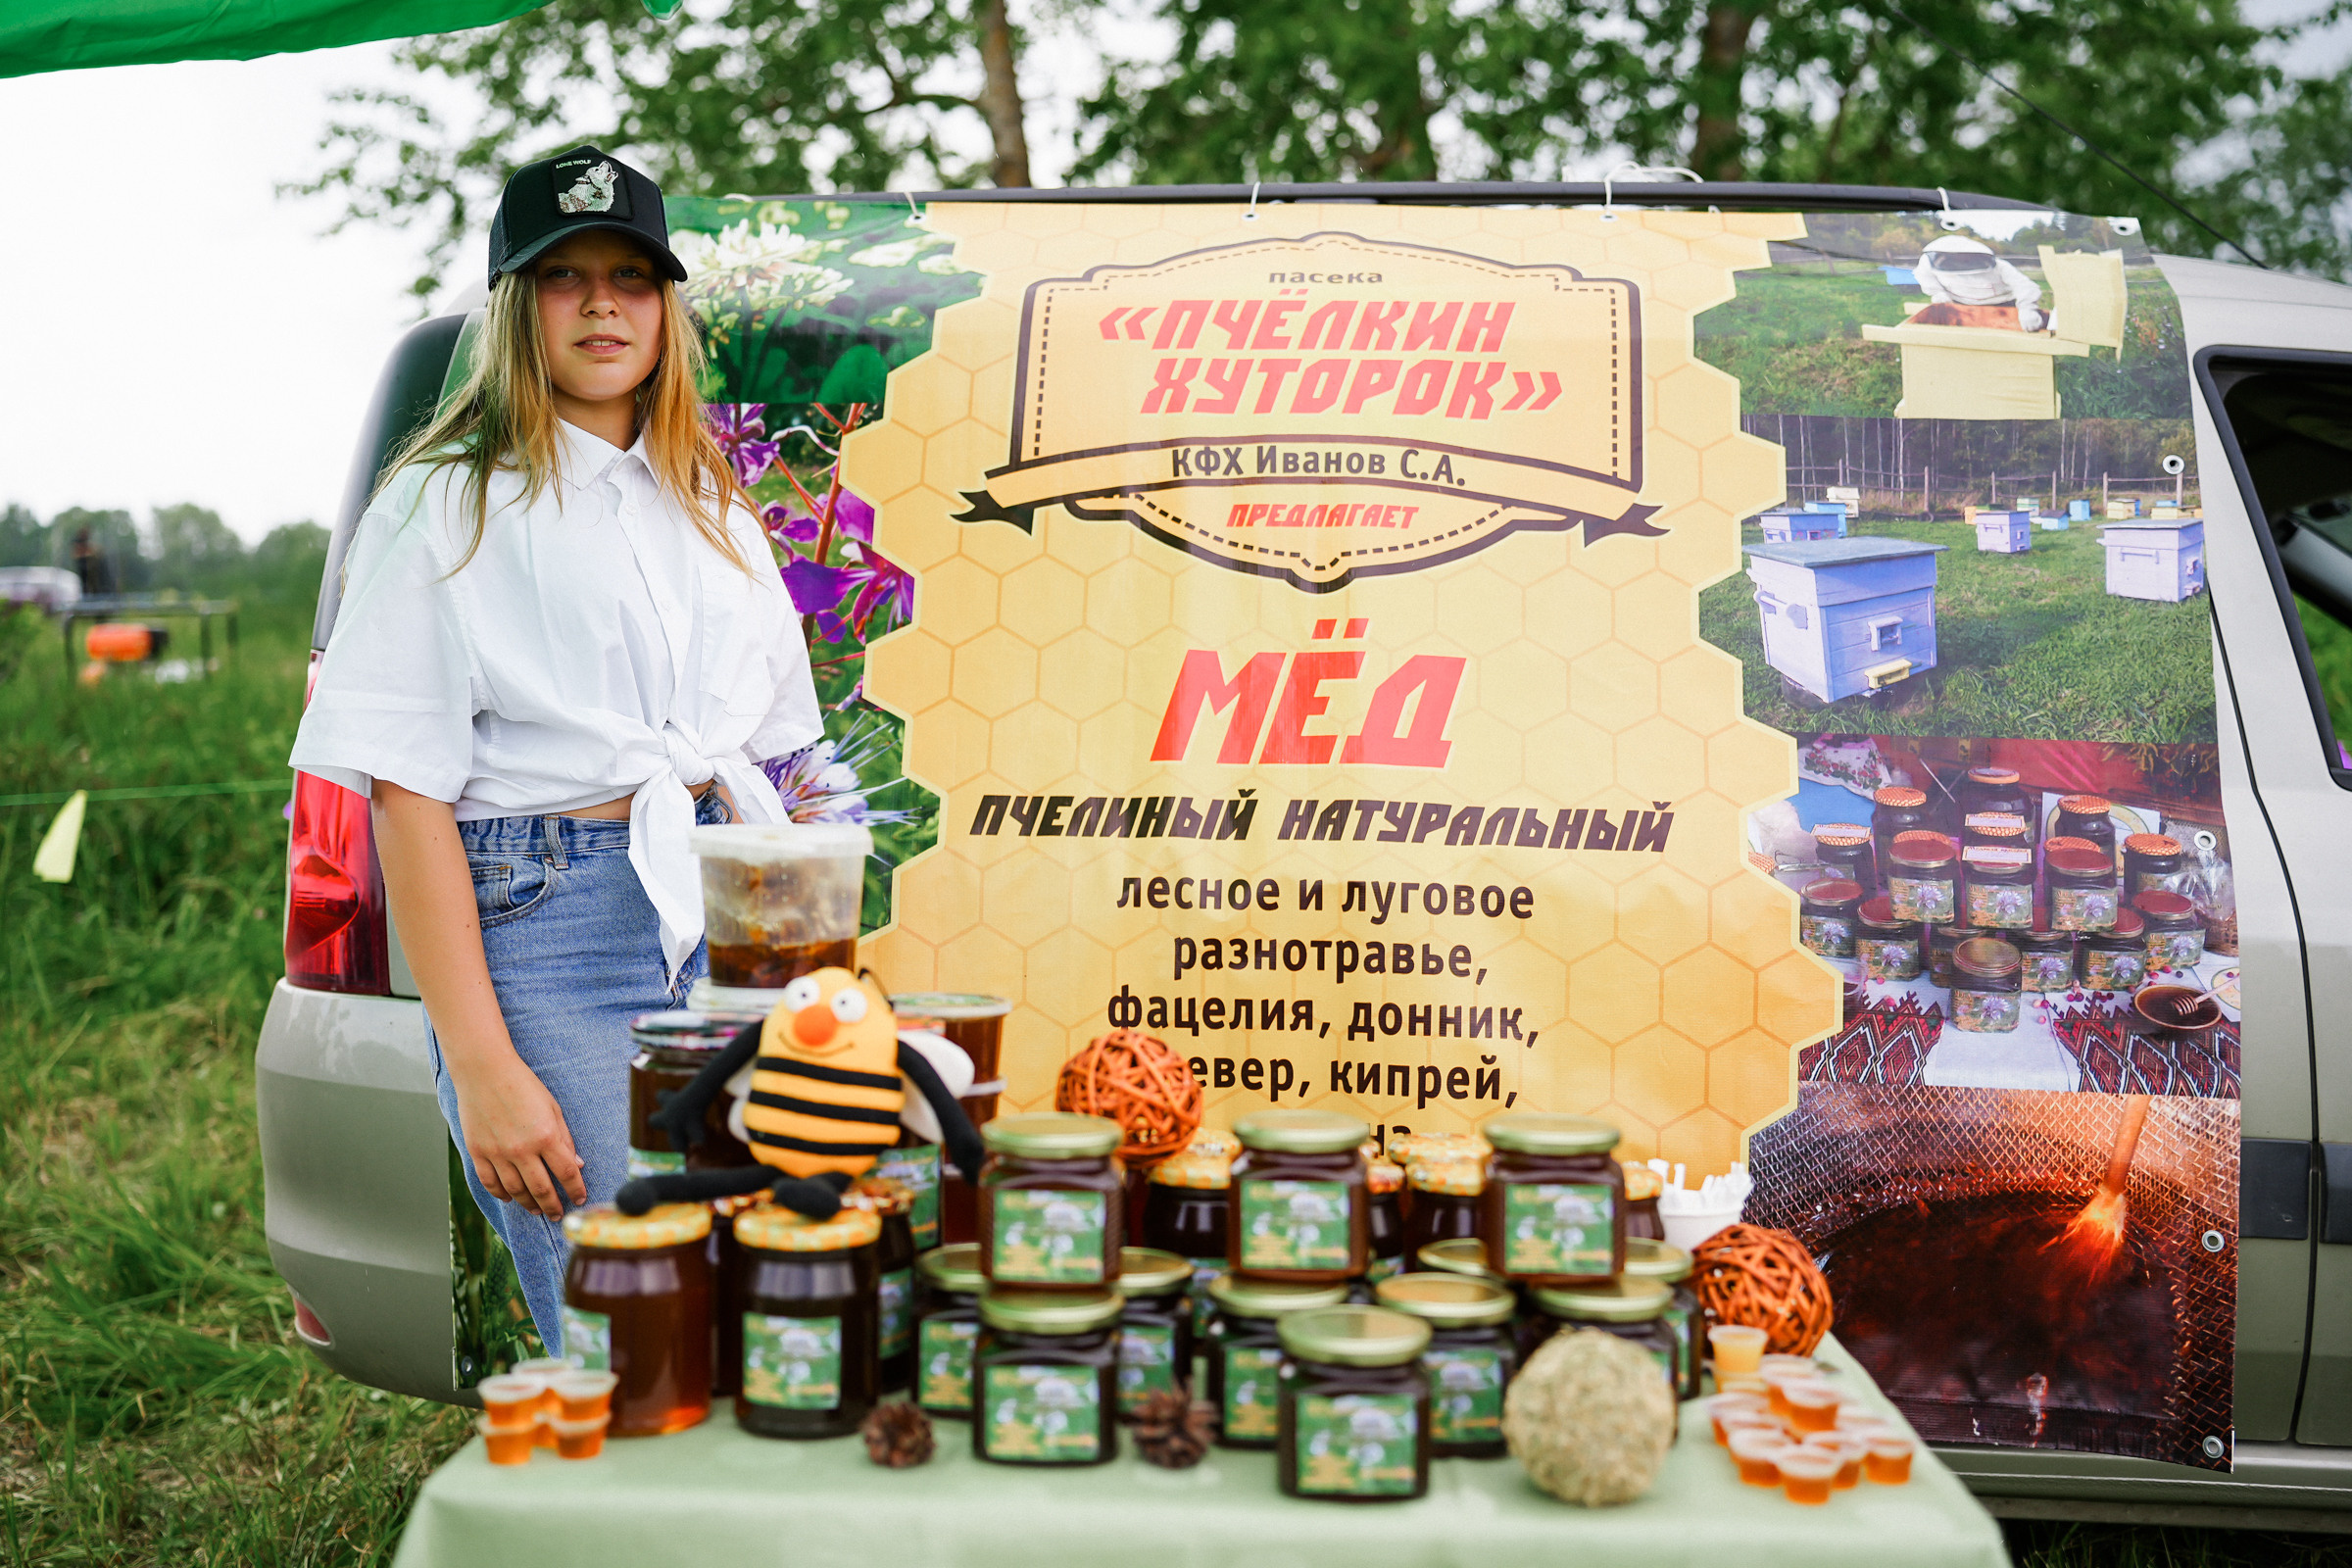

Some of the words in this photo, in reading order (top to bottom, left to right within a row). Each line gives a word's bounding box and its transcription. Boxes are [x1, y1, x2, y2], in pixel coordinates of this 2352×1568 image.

[1268, 270, 1383, 284] пасека
[1099, 288, 1516, 354] «ПЧЁЛКИН
[1140, 357, 1563, 420] ХУТОРОК»
[1171, 447, 1244, 477] КФХ
[1255, 445, 1387, 475] Иванов
[1398, 448, 1466, 486] С.А.
[1225, 503, 1420, 529] ПРЕДЛАГАЕТ
[1149, 617, 1467, 769] МЁД
[969, 788, 1258, 841] ПЧЕЛИНЫЙ
[1276, 800, 1675, 854] НАТУРАЛЬНЫЙ
[1116, 876, 1280, 911] лесное
[1298, 879, 1323, 911] и
[1341, 880, 1535, 926] луговое
[1173, 936, 1488, 986] разнотравье,
[1107, 984, 1331, 1039] фацелия,
[1347, 1002, 1540, 1048] донник,
[1189, 1055, 1310, 1103] евер,
[1330, 1054, 1518, 1110] кипрей,
